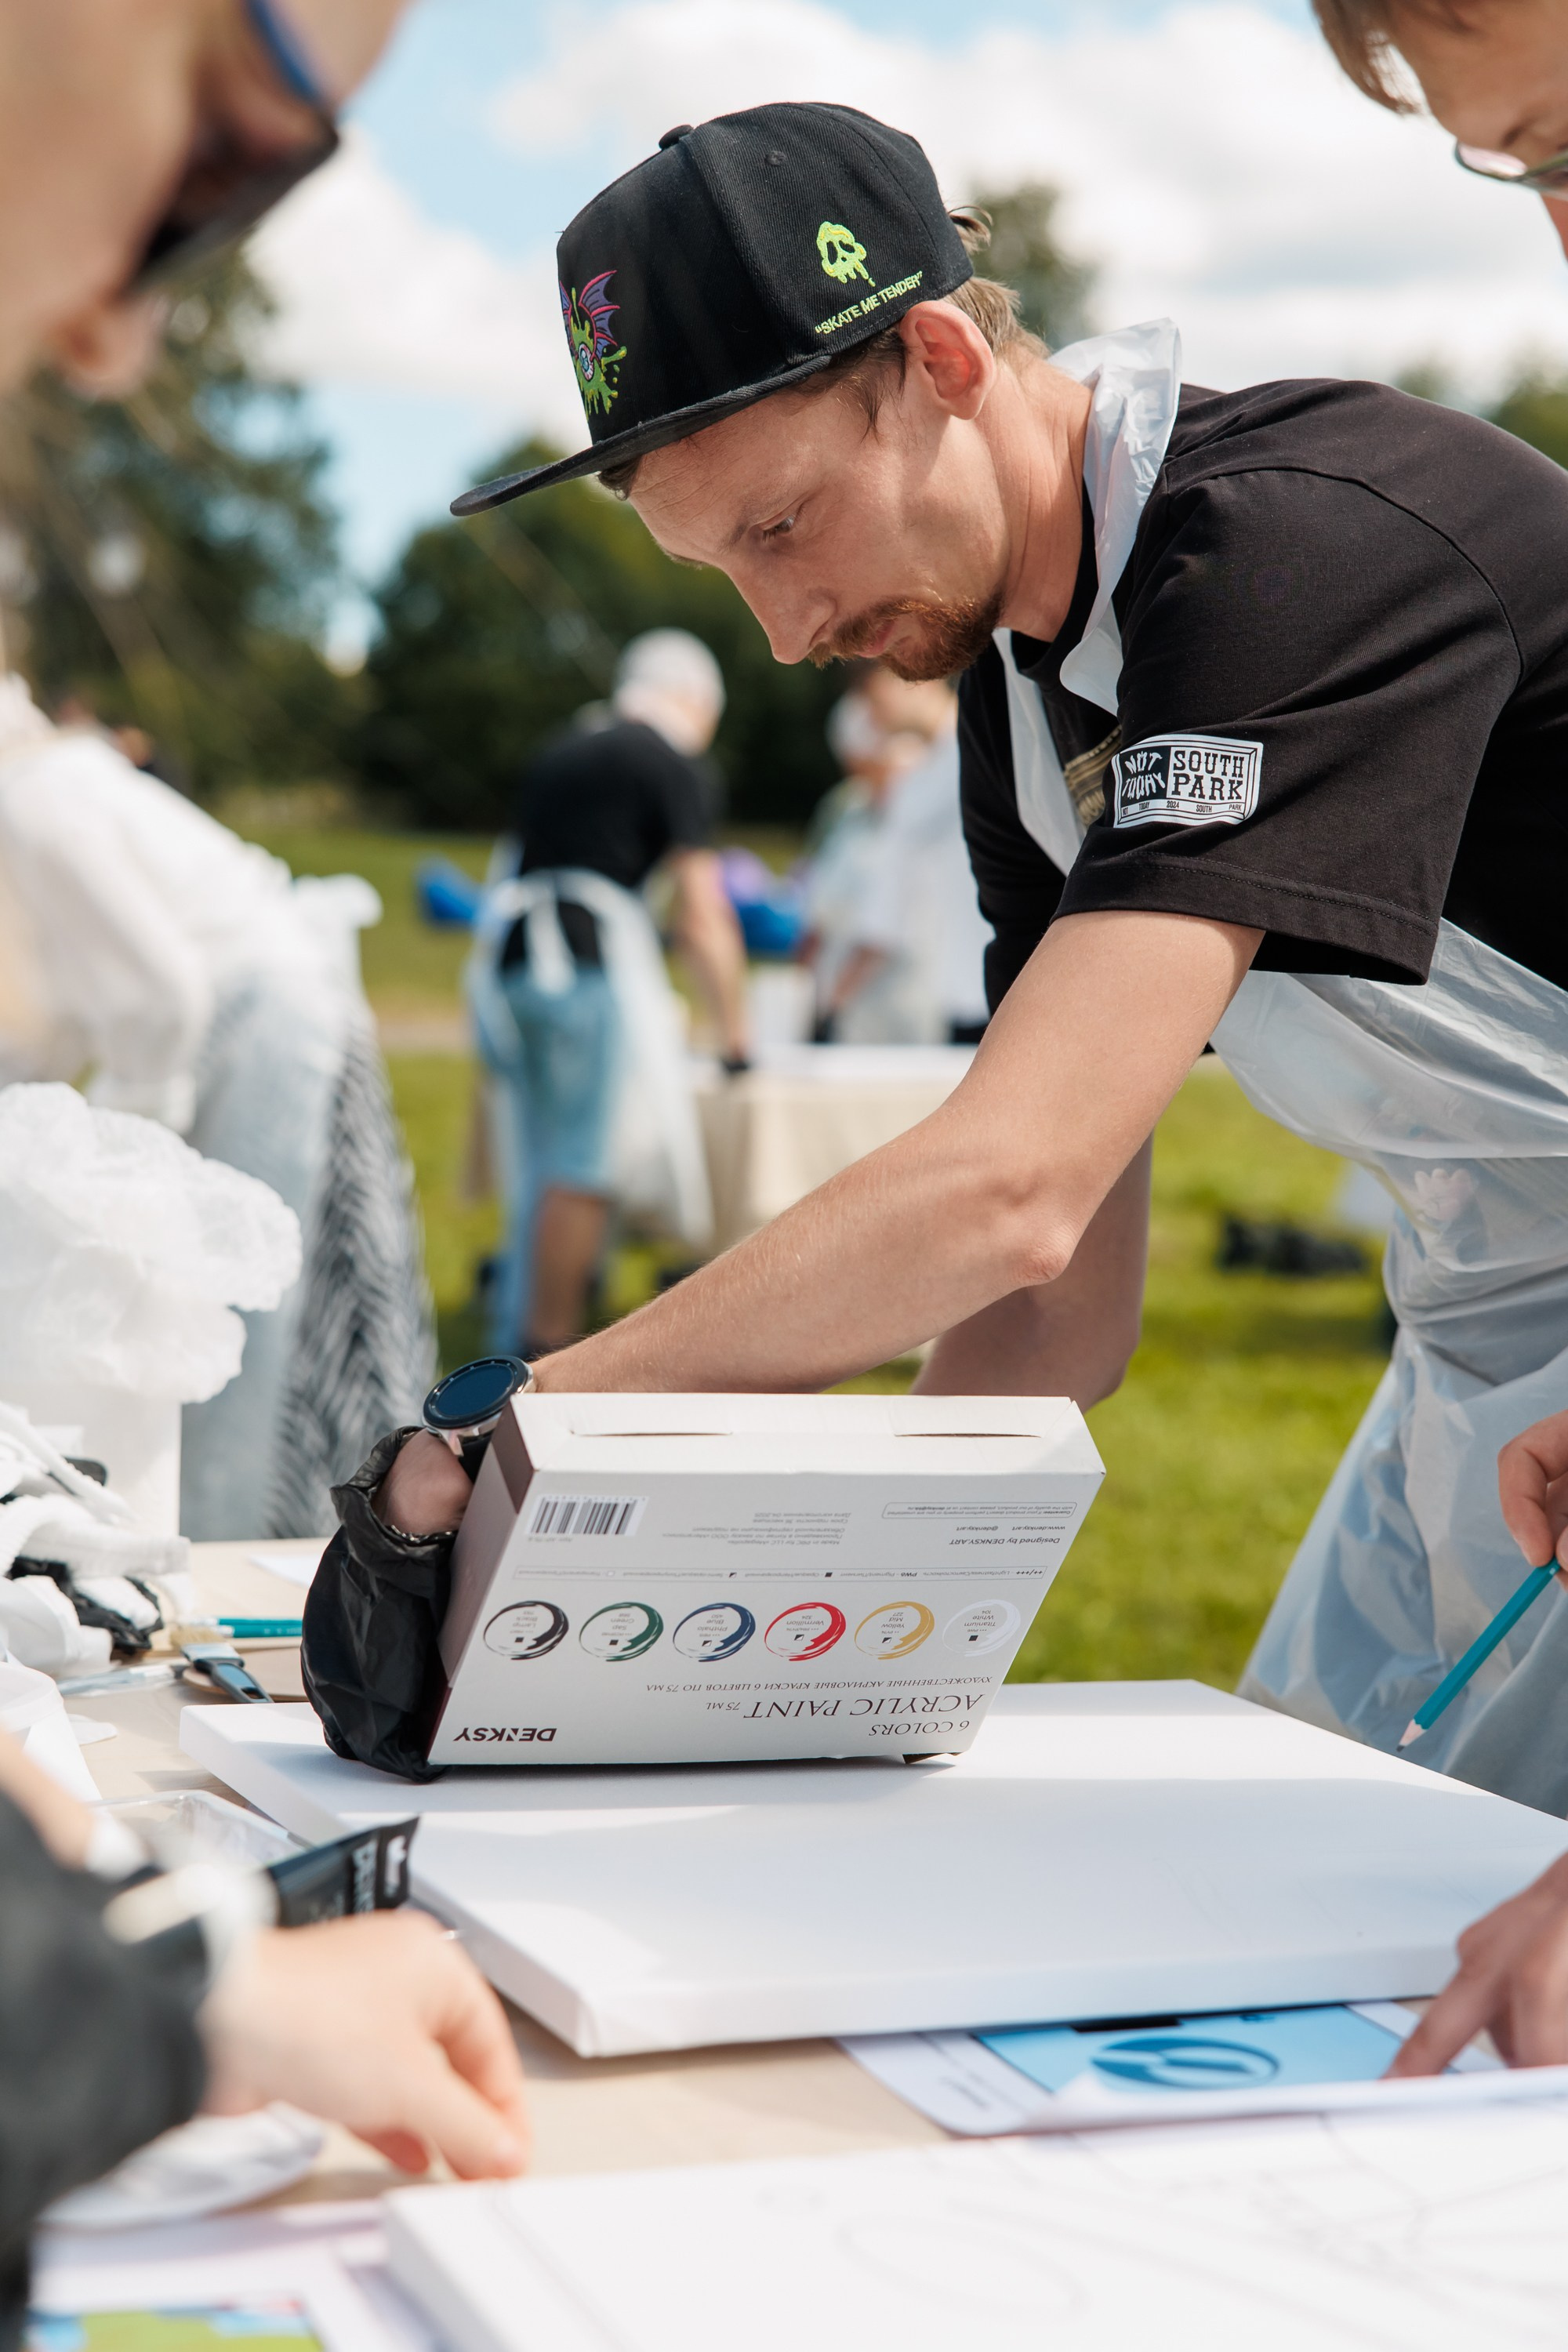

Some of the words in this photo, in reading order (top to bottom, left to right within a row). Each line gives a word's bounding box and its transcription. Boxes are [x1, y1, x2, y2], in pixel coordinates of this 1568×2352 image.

[860, 295, 880, 314] ME
[1125, 751, 1163, 775] NOT
[1174, 750, 1244, 779] SOUTH
[1122, 772, 1166, 800] TODAY
[1171, 773, 1243, 800] PARK
[706, 1682, 751, 1691] ЦВЕТОВ
[764, 1682, 811, 1690] КРАСКИ
[814, 1681, 884, 1690] АКРИЛОВЫЕ
[886, 1676, 993, 1687] ХУДОЖЕСТВЕННЫЕ
[705, 1702, 724, 1711] ML
[726, 1701, 741, 1710] 75
[743, 1700, 842, 1718] PAINT
[849, 1693, 985, 1715] ACRYLIC
[869, 1721, 954, 1736] COLORS
[959, 1721, 970, 1732] 6
